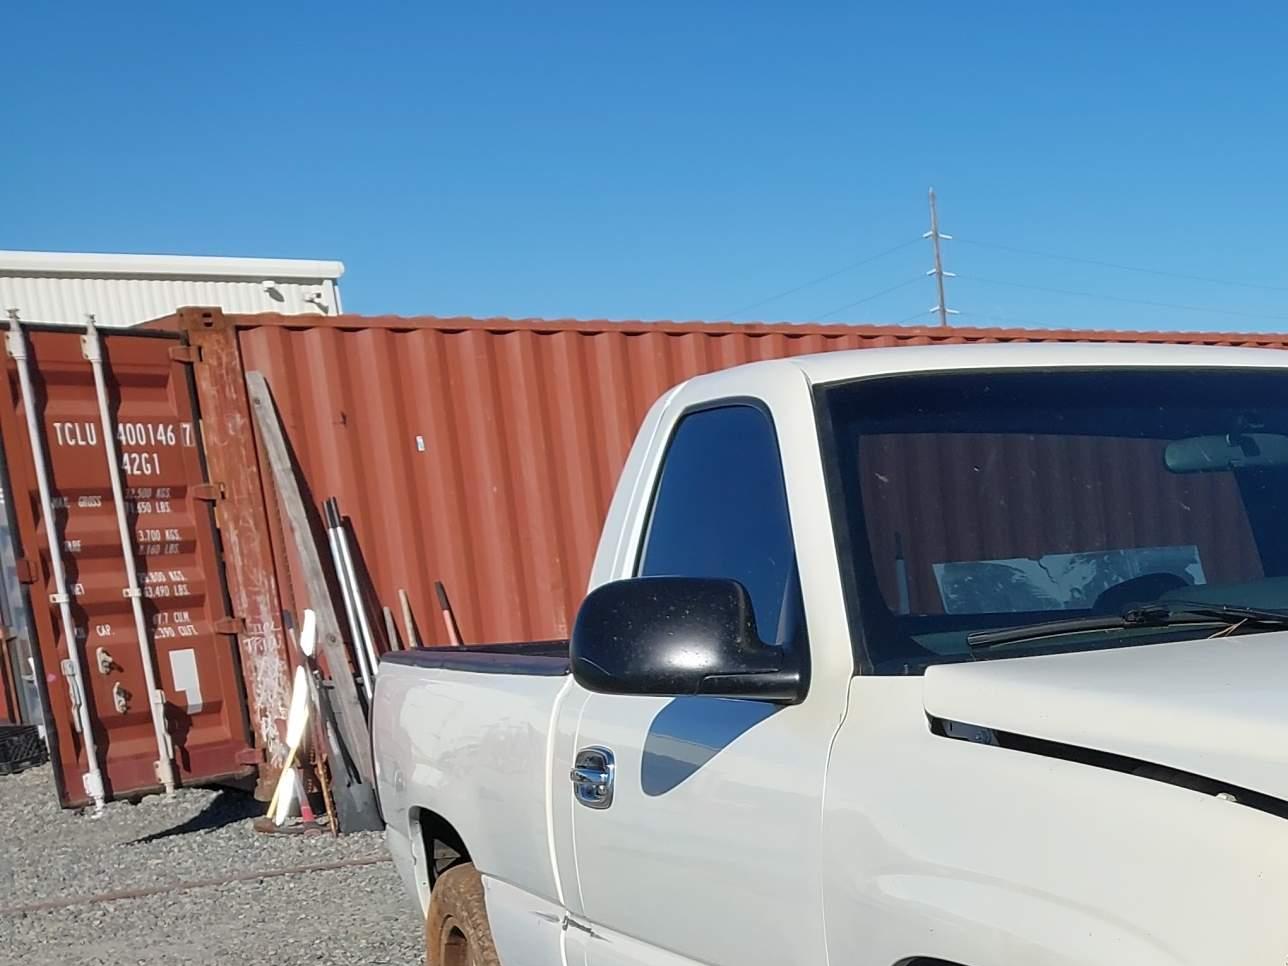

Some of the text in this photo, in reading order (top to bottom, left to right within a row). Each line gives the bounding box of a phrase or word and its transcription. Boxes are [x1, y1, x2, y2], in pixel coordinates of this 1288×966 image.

[53, 422, 191, 447] TCLU 400146 7
[122, 452, 160, 475] 42G1
